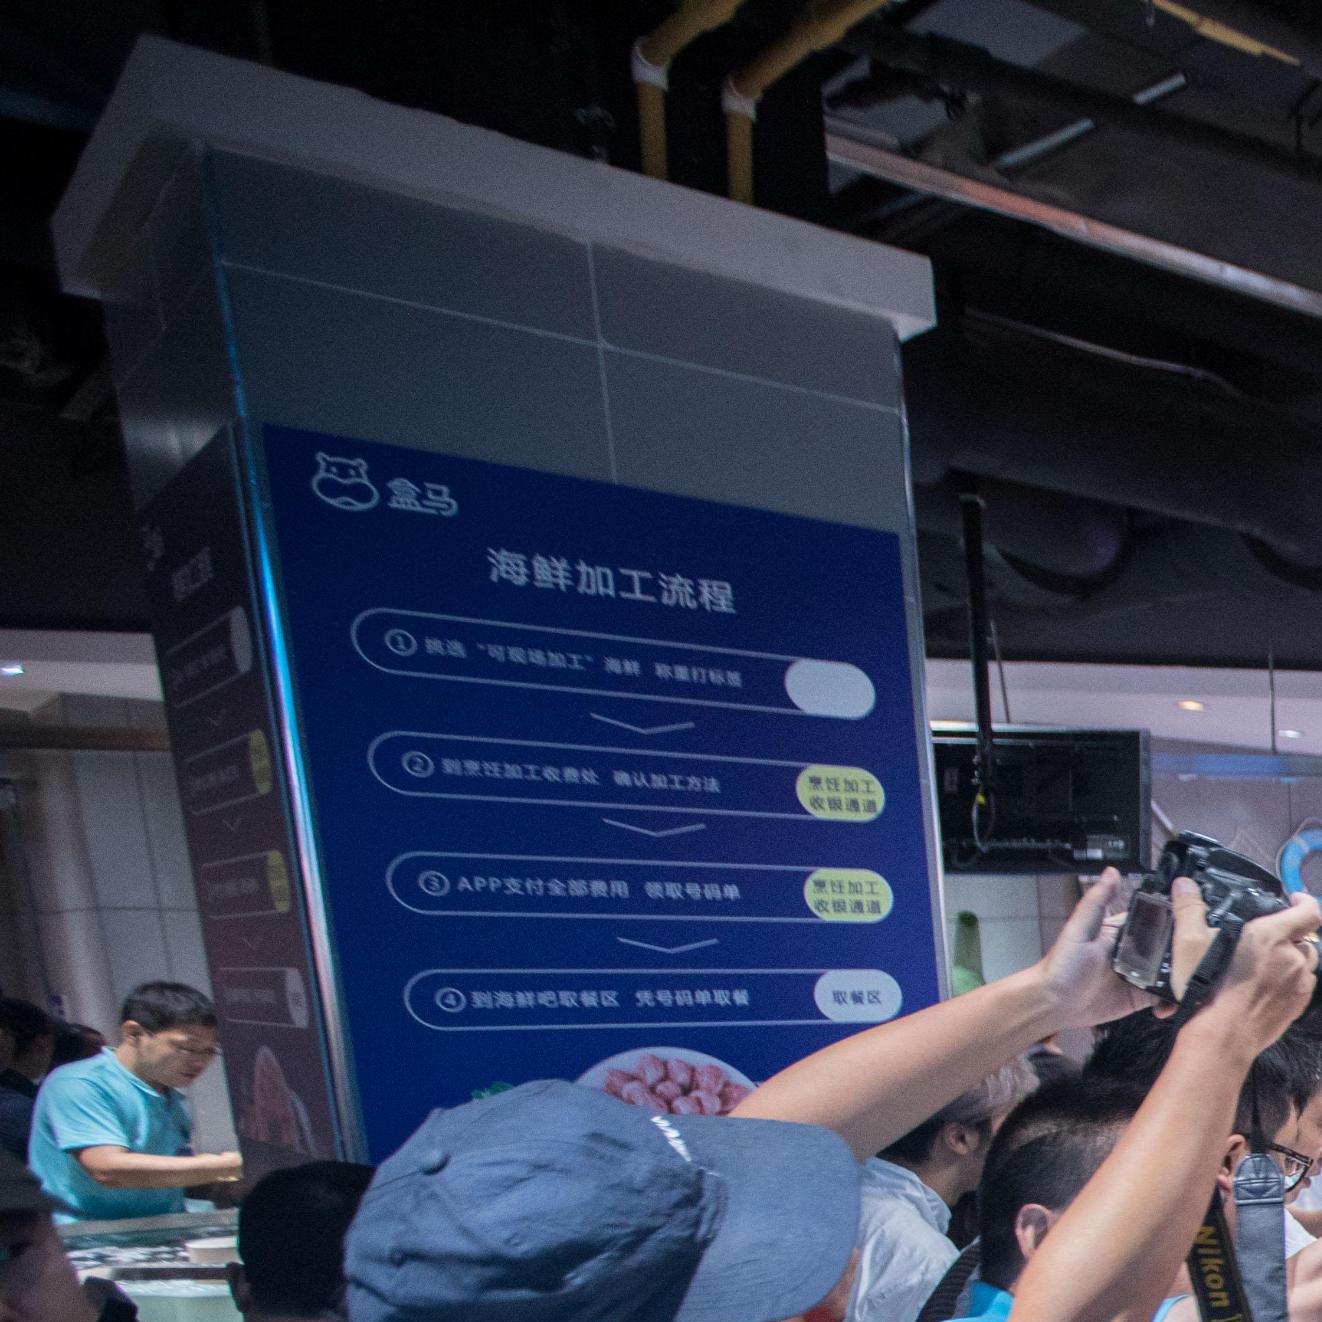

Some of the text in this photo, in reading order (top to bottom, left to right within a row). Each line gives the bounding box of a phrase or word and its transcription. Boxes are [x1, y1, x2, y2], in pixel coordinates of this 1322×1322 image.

[387, 478, 458, 517] 盒马
[487, 547, 737, 615] 海鲜加工流程
[832, 990, 882, 1006] 取餐区
[1196, 1225, 1230, 1308] Nikon
